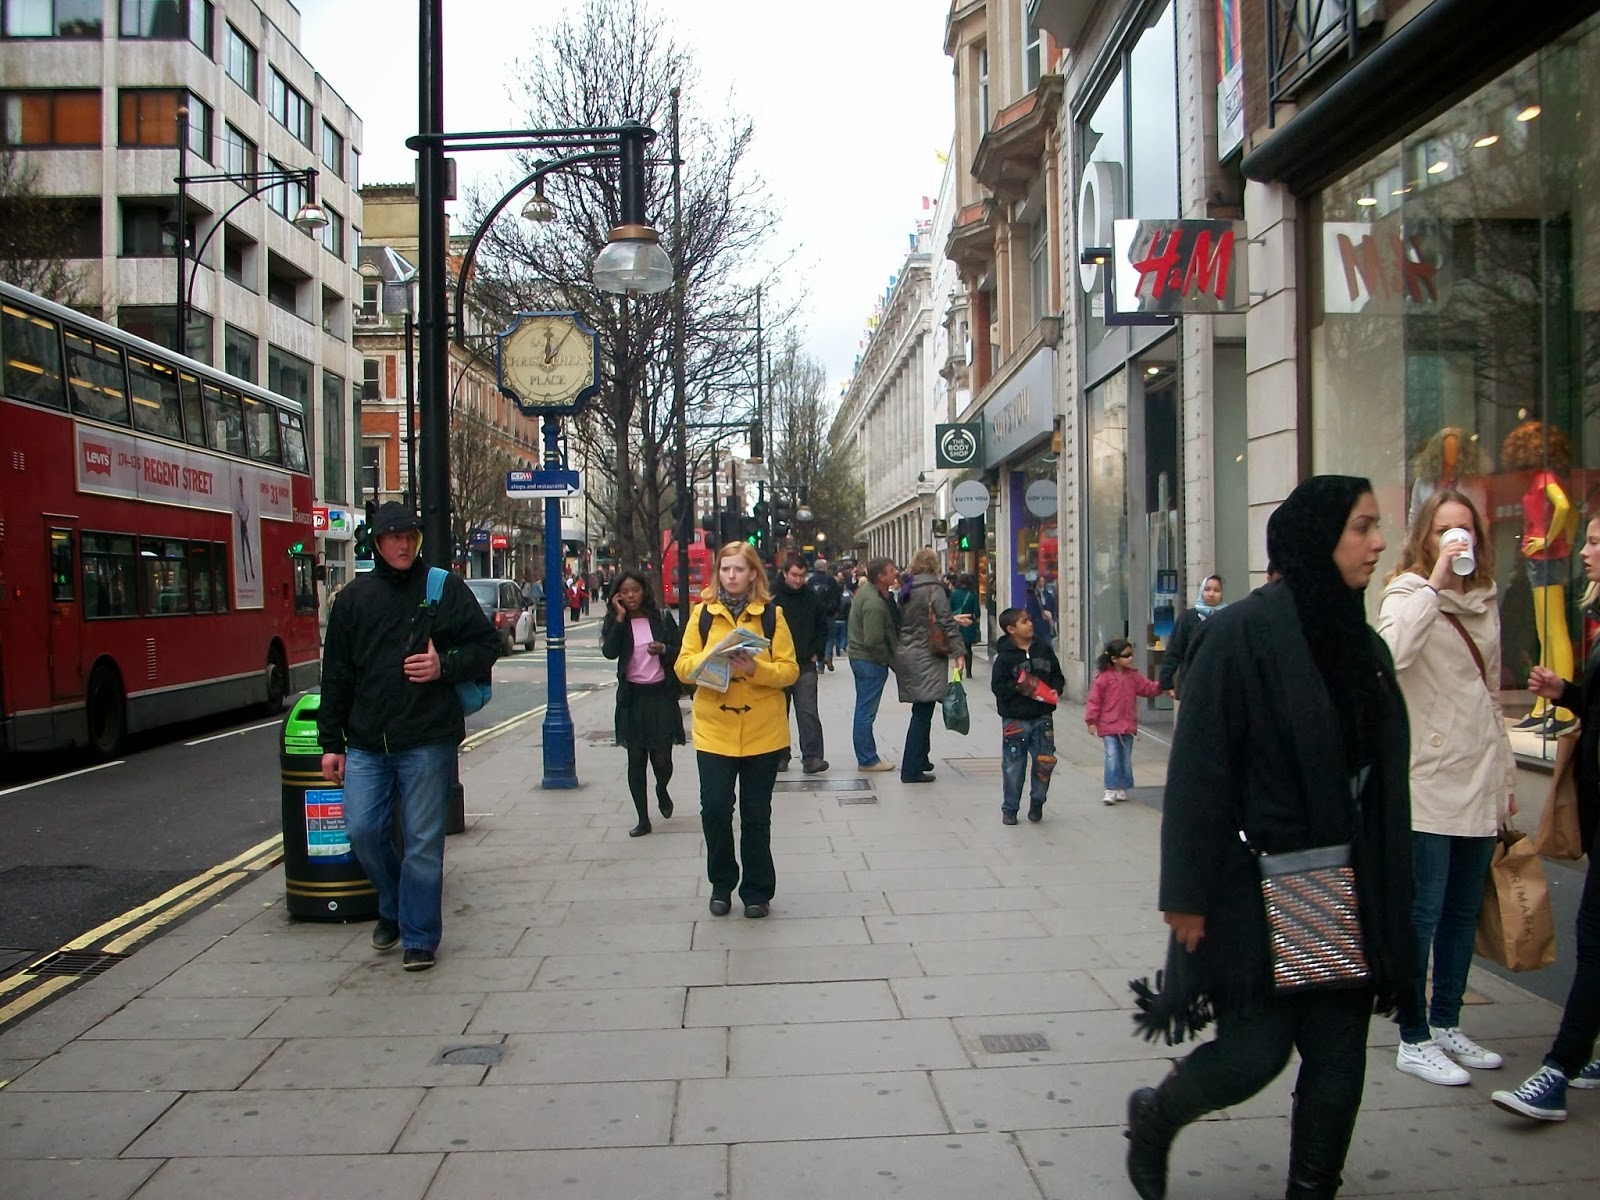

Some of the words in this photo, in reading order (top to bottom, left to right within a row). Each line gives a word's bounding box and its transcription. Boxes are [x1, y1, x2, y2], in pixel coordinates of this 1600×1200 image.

[1132, 228, 1235, 300] H&M
[530, 375, 566, 386] PLACE
[118, 453, 141, 470] 174-176
[143, 456, 180, 488] REGENT
[182, 466, 214, 495] STREET
[270, 484, 279, 505] 31
[1508, 866, 1534, 938] PRIMARK
